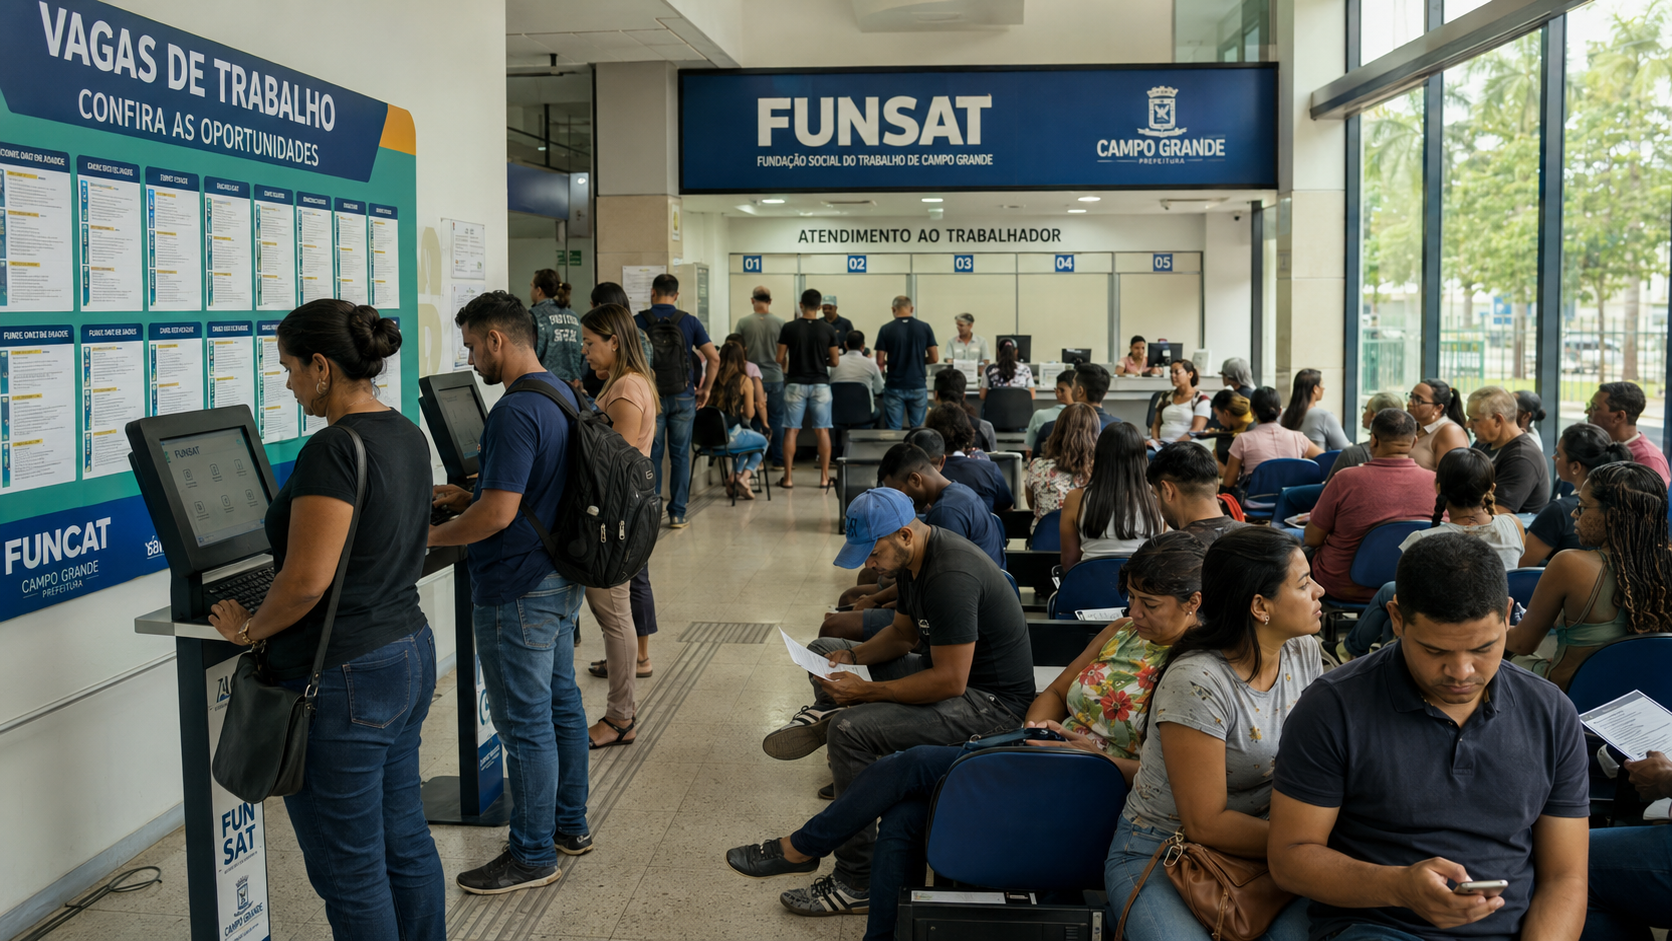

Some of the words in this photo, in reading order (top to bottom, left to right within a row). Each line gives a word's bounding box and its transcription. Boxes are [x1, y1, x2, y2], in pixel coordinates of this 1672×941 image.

[39, 0, 157, 83] VAGAS
[167, 43, 206, 98] DE
[214, 58, 336, 132] TRABALHO
[78, 89, 167, 136] CONFIRA
[172, 112, 195, 141] AS
[201, 117, 319, 167] OPORTUNIDADES
[758, 95, 992, 147] FUNSAT
[1096, 139, 1156, 157] CAMPO
[1159, 137, 1226, 156] GRANDE
[757, 153, 806, 169] FUNDAÇÃO
[808, 154, 841, 167] SOCIAL
[843, 154, 856, 167] DO
[858, 154, 906, 166] TRABALHO
[908, 154, 919, 166] DE
[922, 154, 954, 166] CAMPO
[956, 154, 993, 165] GRANDE
[798, 229, 911, 243] ATENDIMENTO
[917, 228, 940, 243] AO
[946, 228, 1062, 243] TRABALHADOR
[745, 258, 760, 270] 01
[849, 258, 865, 270] 02
[955, 257, 972, 270] 03
[1056, 257, 1073, 270] 04
[1154, 256, 1171, 269] 05
[5, 516, 111, 575] FUNCAT
[22, 572, 58, 594] CAMPO
[61, 560, 99, 582] GRANDE
[221, 801, 255, 838] FUN
[223, 824, 256, 865] SAT
